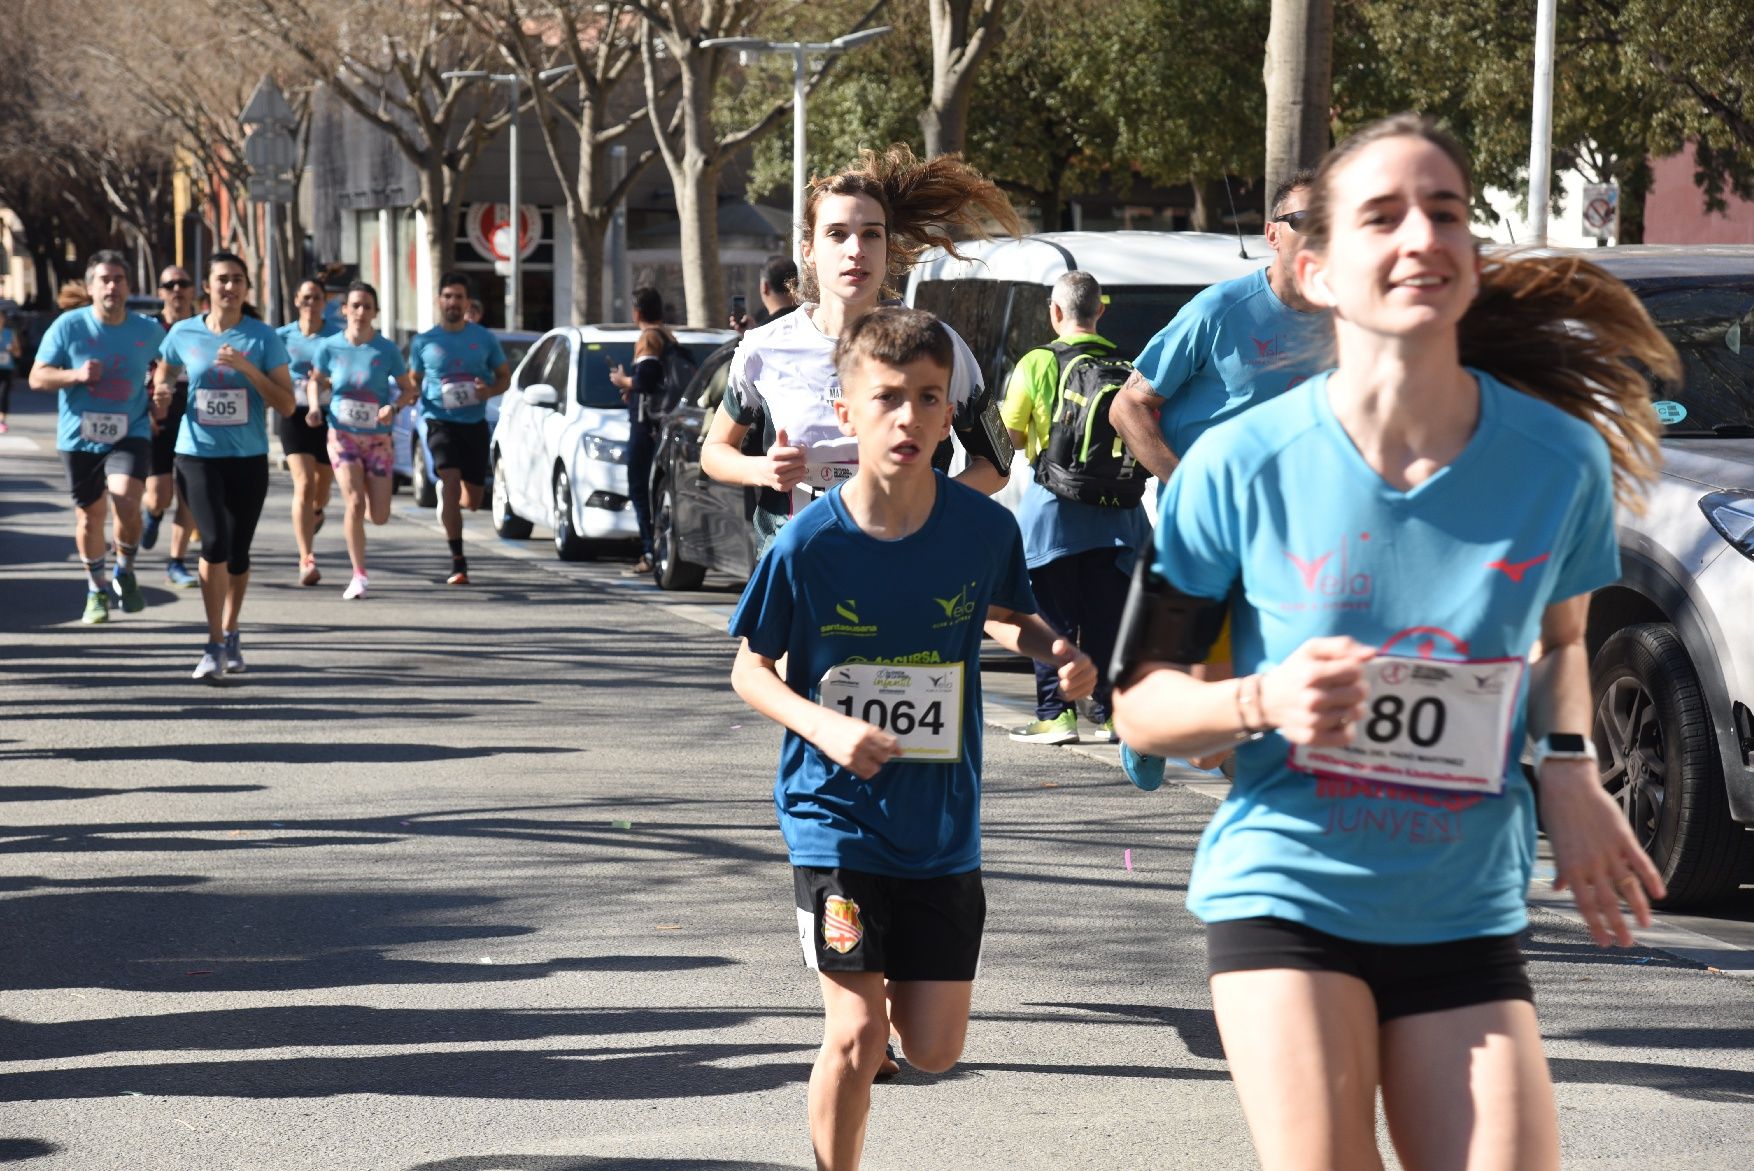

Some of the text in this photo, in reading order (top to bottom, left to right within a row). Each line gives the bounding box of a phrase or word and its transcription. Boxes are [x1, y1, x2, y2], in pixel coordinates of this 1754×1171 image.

[207, 401, 237, 415] 505
[91, 422, 119, 436] 128
[1283, 532, 1372, 593] Vela
[933, 581, 976, 618] Vela
[837, 695, 945, 736] 1064
[1366, 694, 1447, 748] 80
